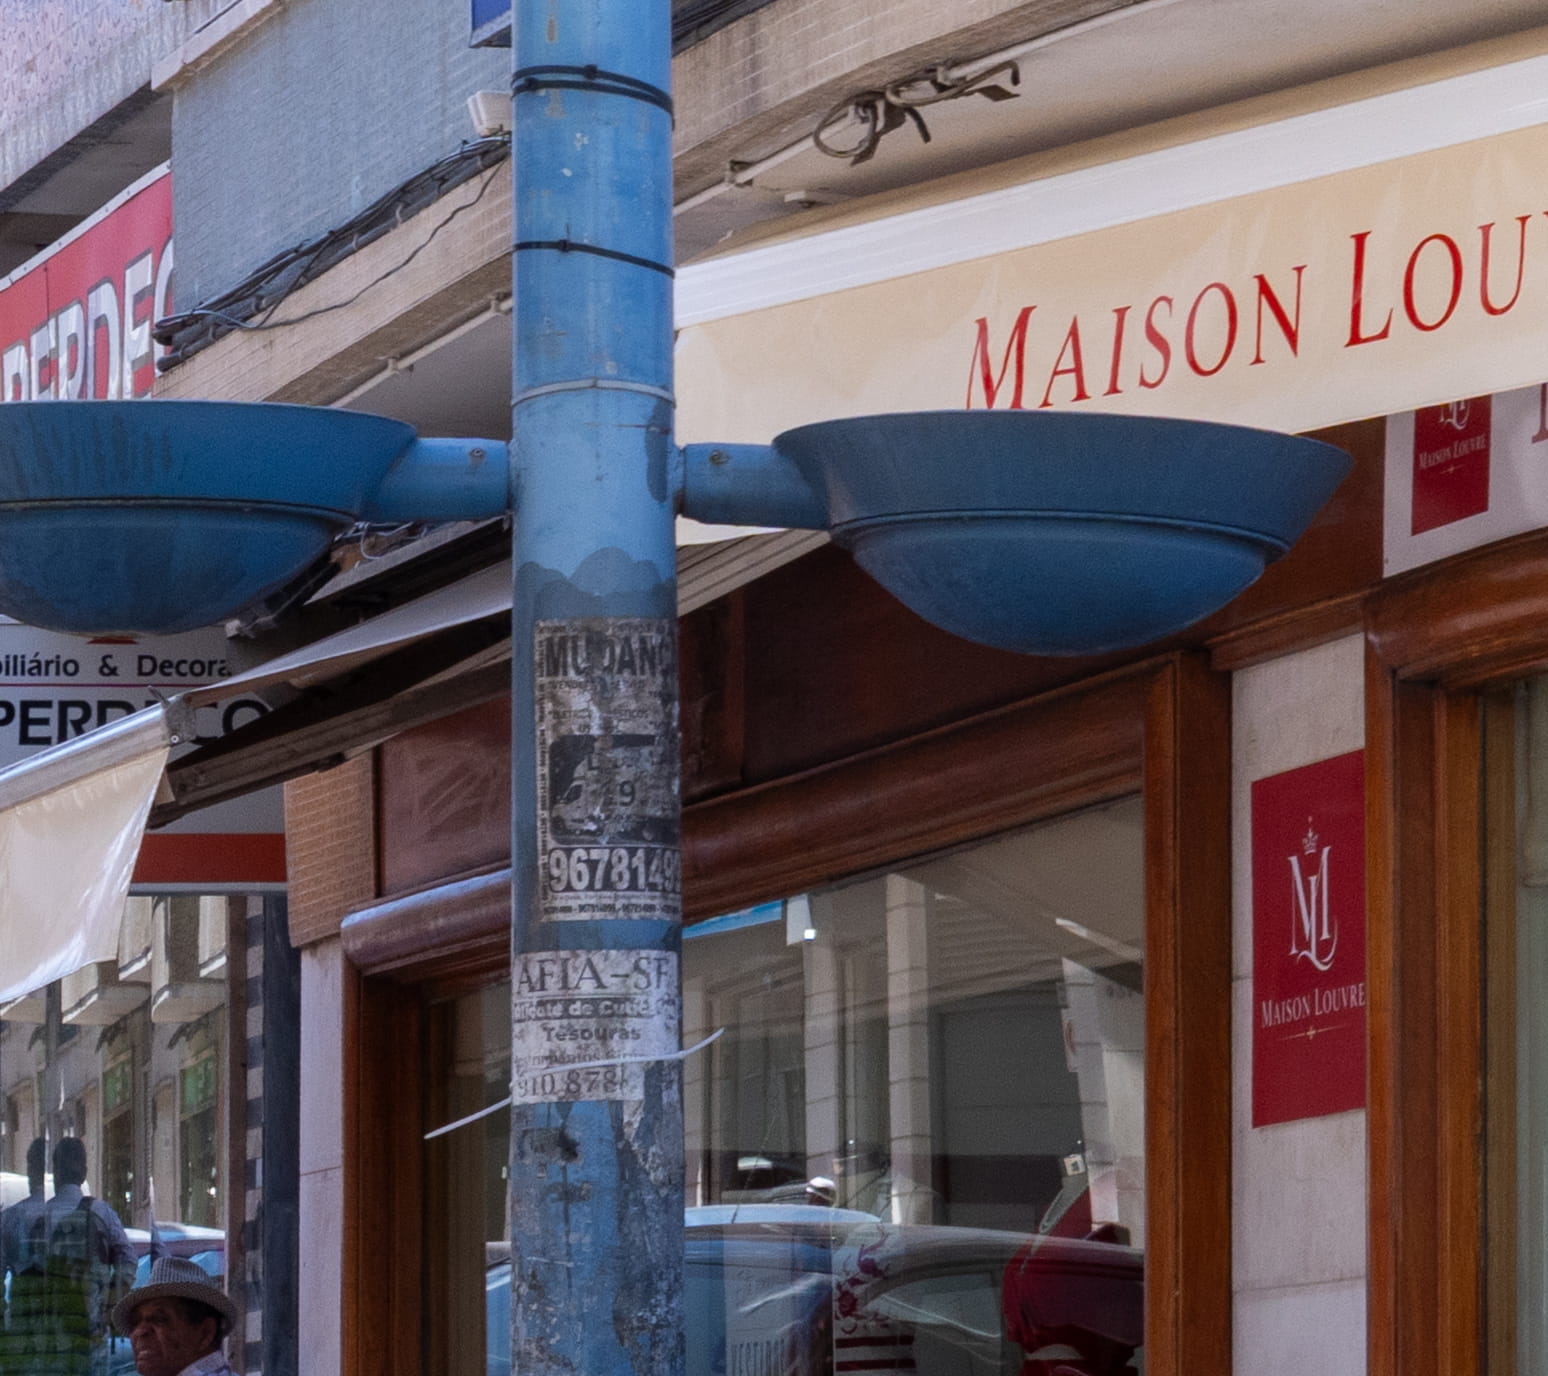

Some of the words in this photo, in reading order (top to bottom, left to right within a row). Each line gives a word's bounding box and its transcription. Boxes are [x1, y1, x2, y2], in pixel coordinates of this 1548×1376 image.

[965, 263, 1307, 412] MAISON
[0, 651, 81, 678] iliário
[97, 653, 120, 677] &
[1260, 992, 1311, 1029] MAISON
[1313, 980, 1367, 1019] LOUVRE
[542, 1022, 642, 1042] Tesouras
